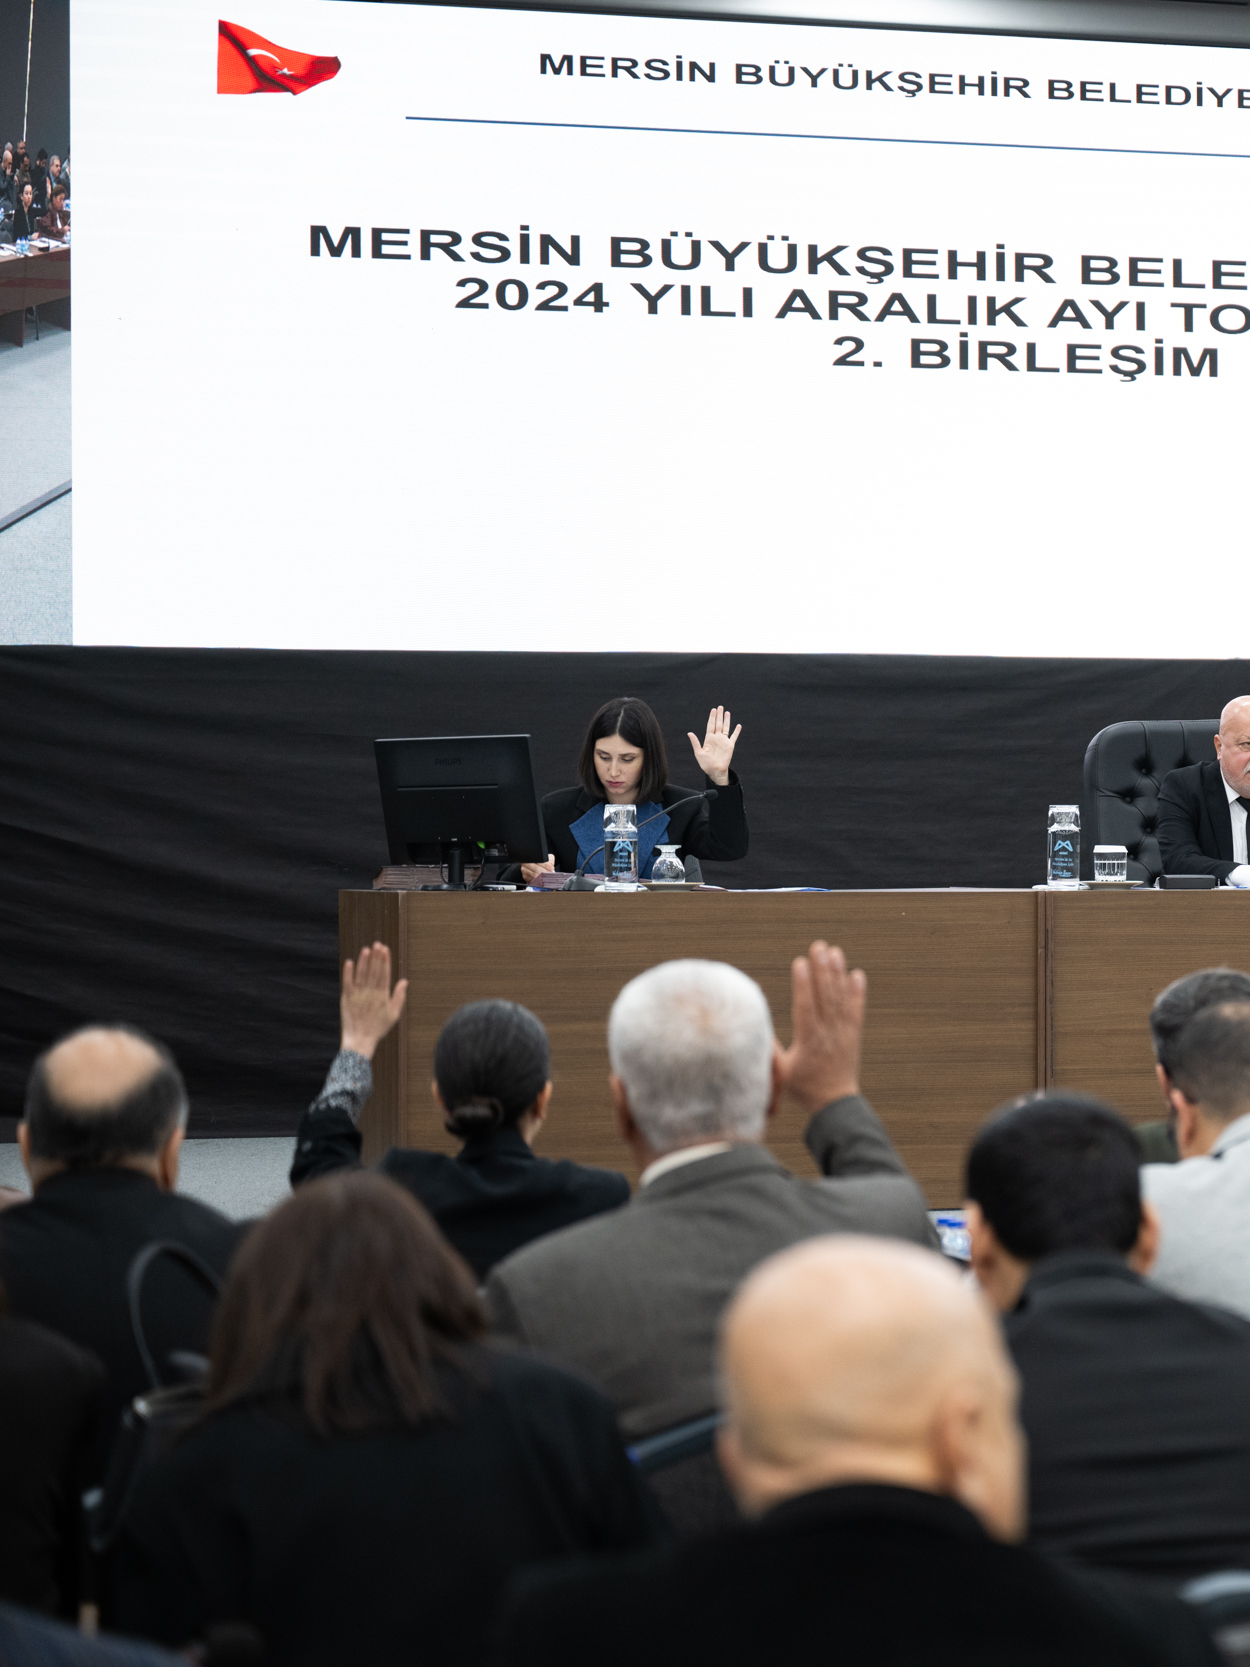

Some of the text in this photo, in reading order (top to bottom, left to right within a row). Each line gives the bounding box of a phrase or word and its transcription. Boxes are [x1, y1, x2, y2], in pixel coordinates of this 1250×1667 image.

[539, 53, 716, 83] MERSİN
[735, 60, 1032, 99] BÜYÜKŞEHİR
[310, 225, 581, 266] MERSİN
[610, 231, 1057, 284] BÜYÜKŞEHİR
[455, 277, 610, 313] 2024
[630, 283, 753, 318] YILI
[774, 289, 1029, 328] ARALIK
[1046, 298, 1146, 332] AYI
[832, 332, 1218, 383] 2. BİRLEŞİM
